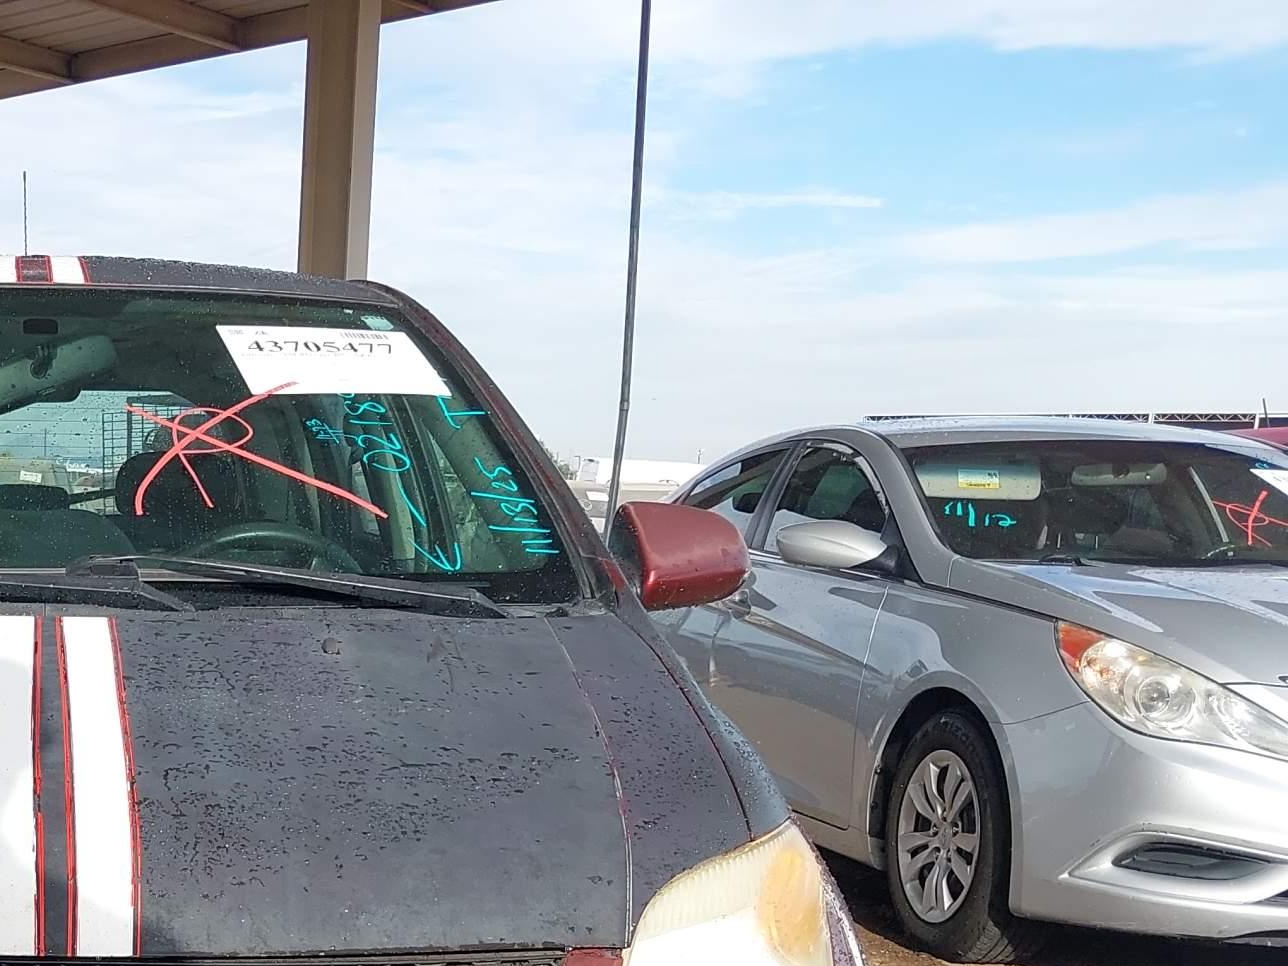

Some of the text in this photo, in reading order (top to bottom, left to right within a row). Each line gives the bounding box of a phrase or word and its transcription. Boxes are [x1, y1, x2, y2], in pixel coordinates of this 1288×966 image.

[247, 340, 393, 355] 43705477
[470, 455, 561, 558] 11/13/25
[943, 500, 1017, 528] 11/12
